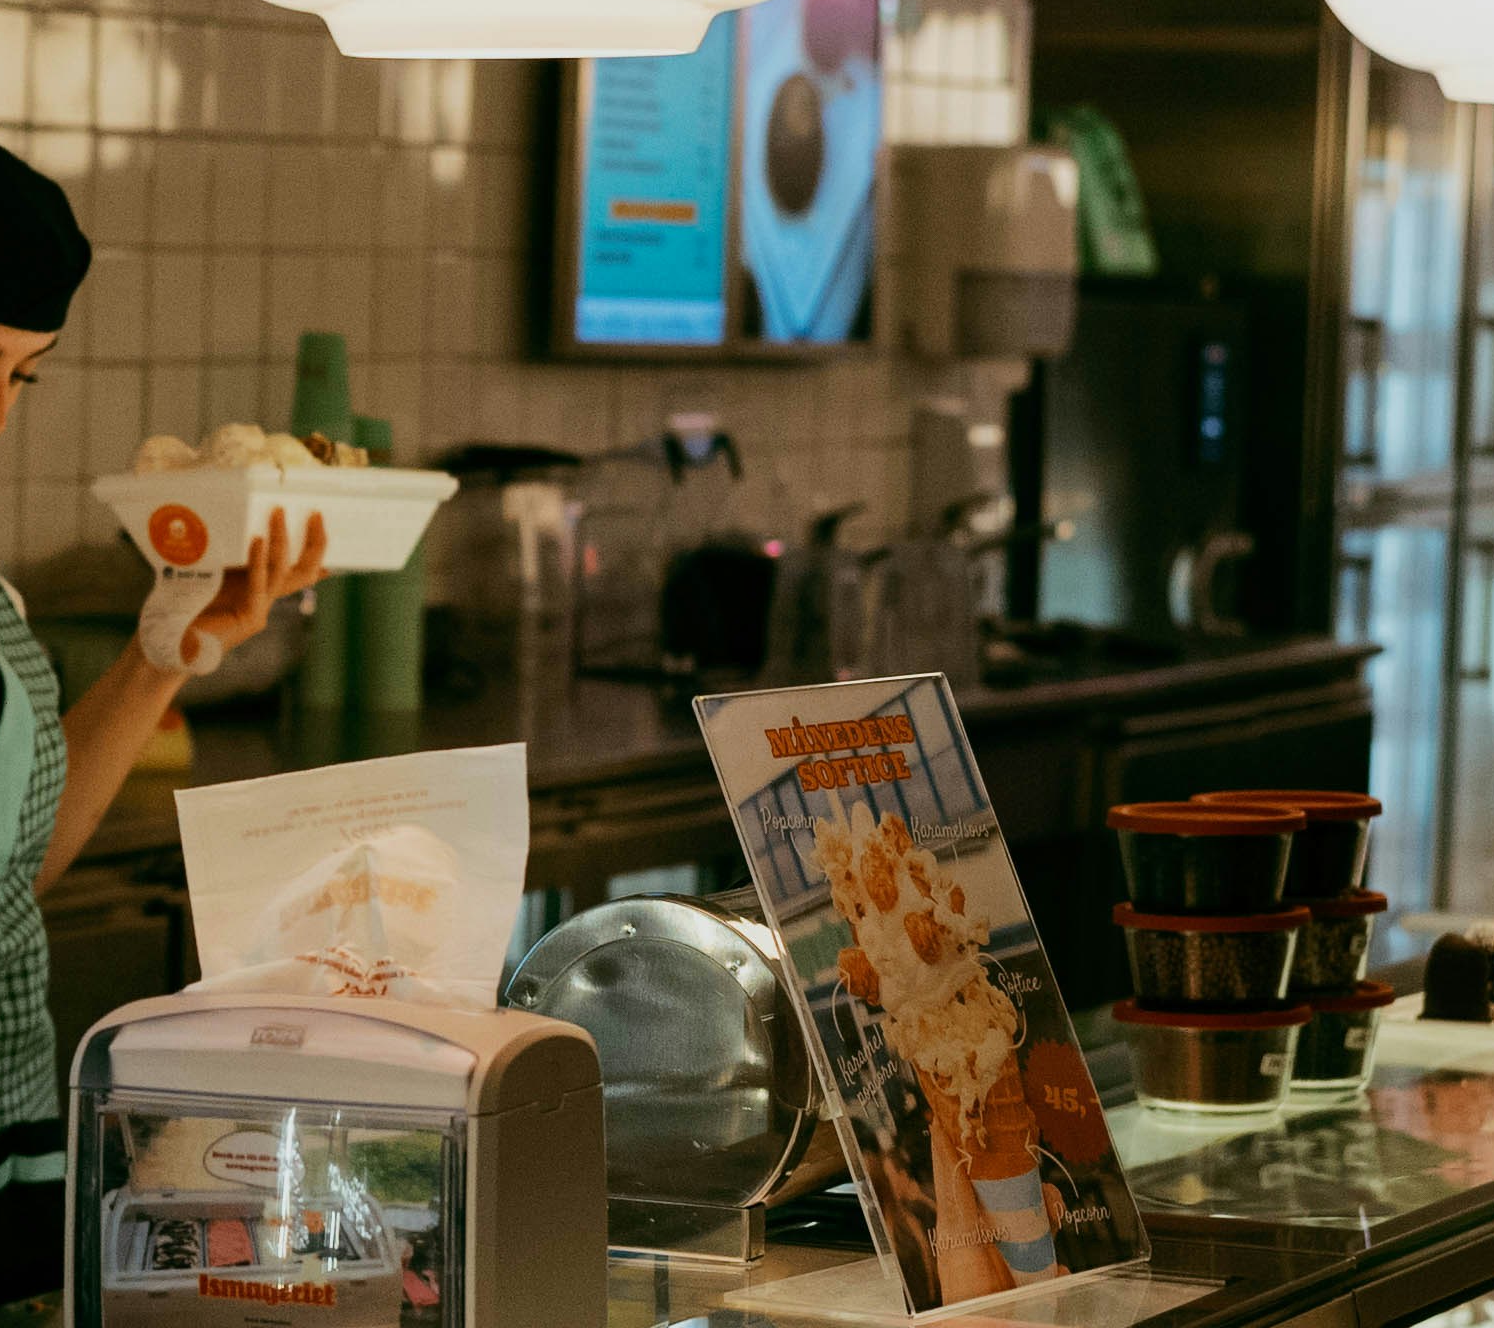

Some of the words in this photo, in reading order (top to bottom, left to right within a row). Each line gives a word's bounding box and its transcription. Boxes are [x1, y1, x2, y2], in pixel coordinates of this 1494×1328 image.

[765, 715, 915, 758] MÅNEDENS
[796, 751, 911, 792] SOFTICE
[760, 807, 818, 841] Popcorn
[911, 815, 990, 845] Karamelsovs
[998, 971, 1041, 1007] Softice
[837, 1024, 884, 1087] Karamel
[856, 1058, 899, 1119] popcorn
[1053, 1201, 1111, 1236] Popcorn
[198, 1273, 336, 1307] Ismageriet
